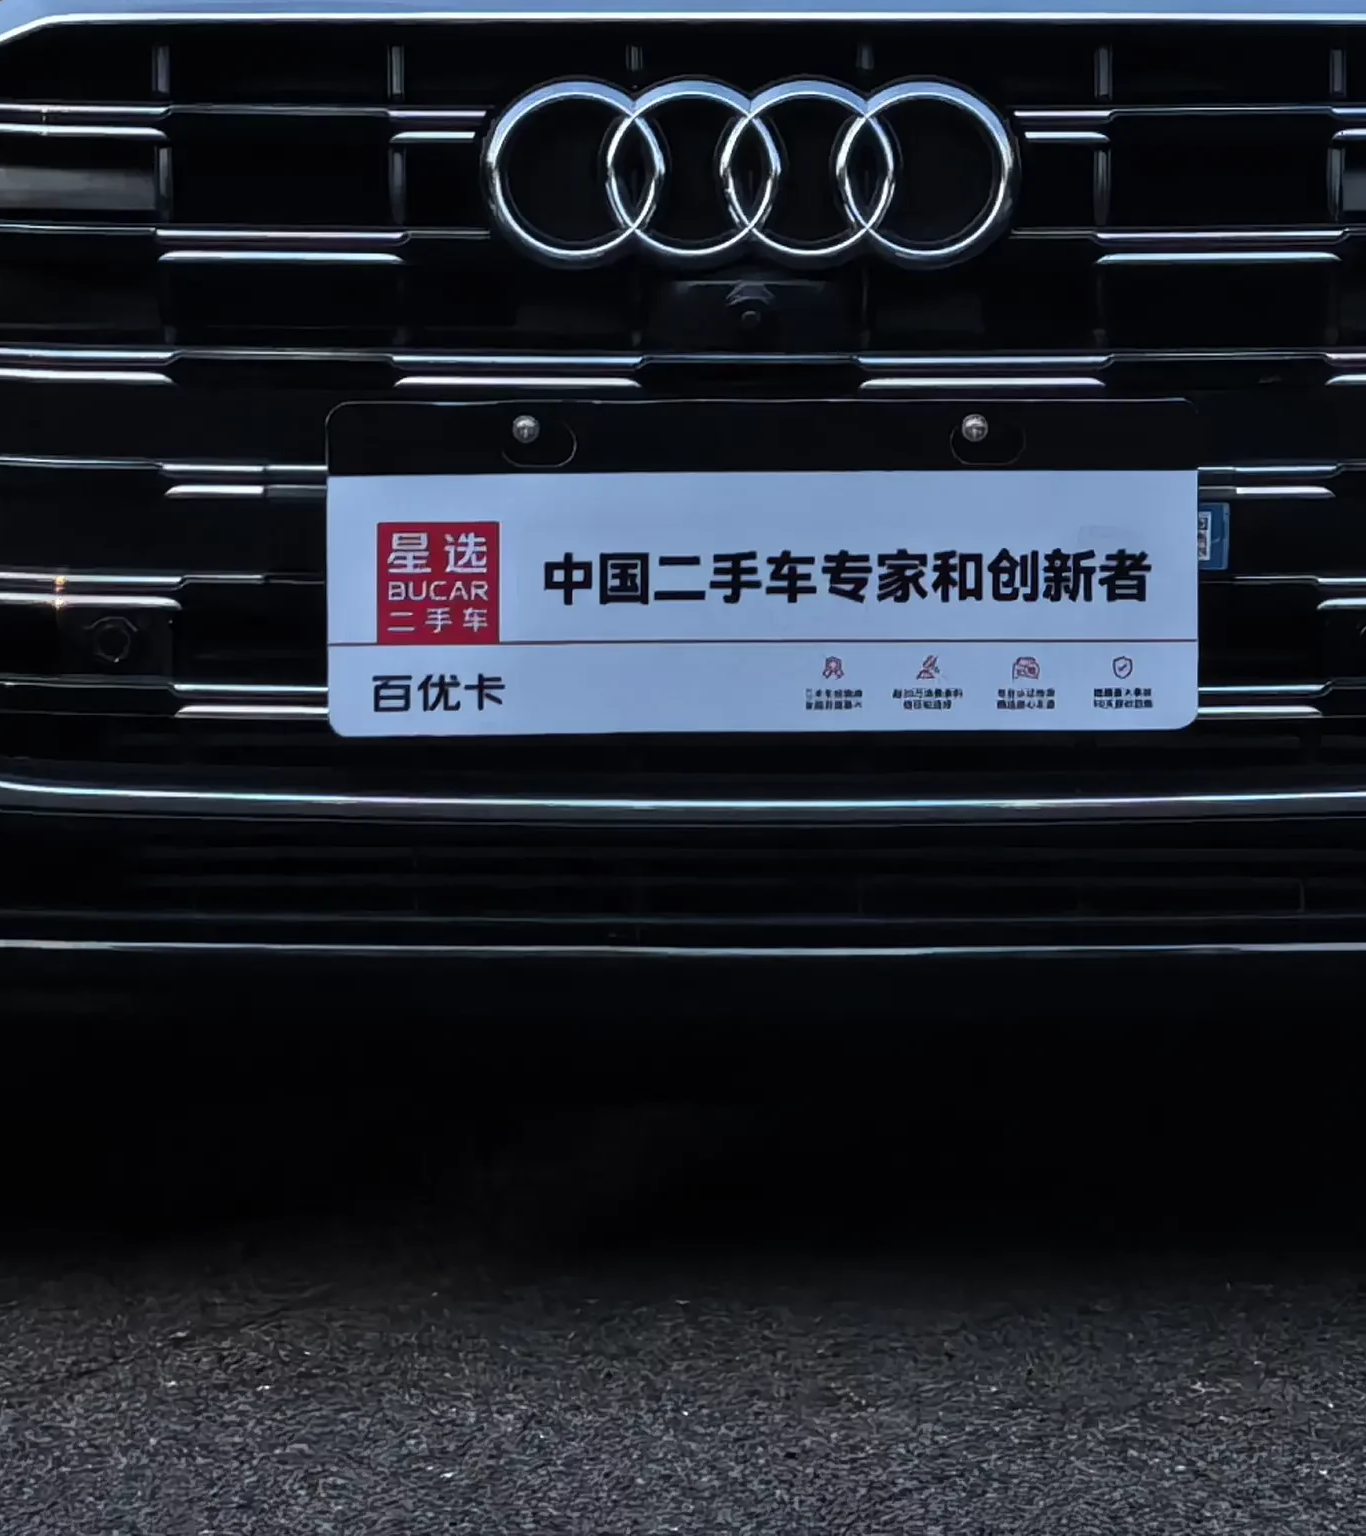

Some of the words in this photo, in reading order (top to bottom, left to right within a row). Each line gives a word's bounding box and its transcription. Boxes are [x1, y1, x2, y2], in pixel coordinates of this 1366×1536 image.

[387, 532, 488, 574] 星选
[388, 580, 489, 601] BUCAR
[543, 547, 1153, 606] 中国二手车专家和创新者
[387, 607, 488, 634] 二手车
[372, 673, 506, 713] 百优卡
